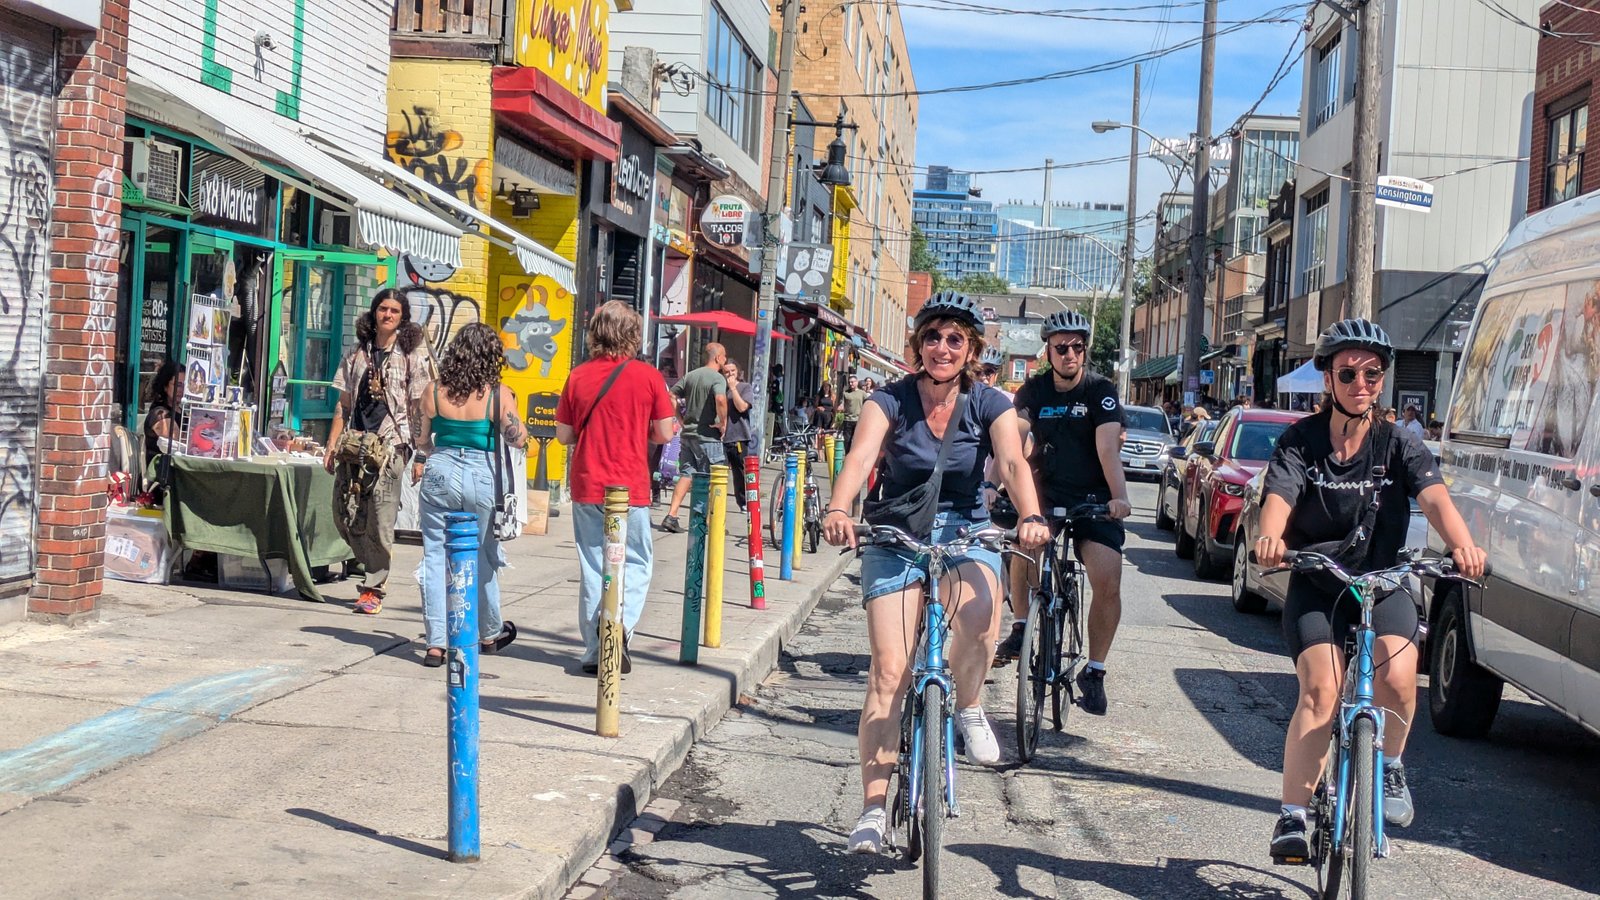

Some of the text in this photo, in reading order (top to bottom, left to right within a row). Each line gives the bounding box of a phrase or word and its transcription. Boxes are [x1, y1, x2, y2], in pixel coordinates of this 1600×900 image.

[199, 169, 258, 225] 6x8 Market
[1377, 186, 1432, 204] Kensington Av
[720, 203, 743, 211] FRUTA
[711, 224, 743, 233] TACOS
[152, 299, 168, 317] 80+
[1407, 397, 1420, 405] FOR
[534, 406, 556, 415] C'est
[1512, 459, 1530, 482] Toronto
[1306, 465, 1394, 496] Champn
